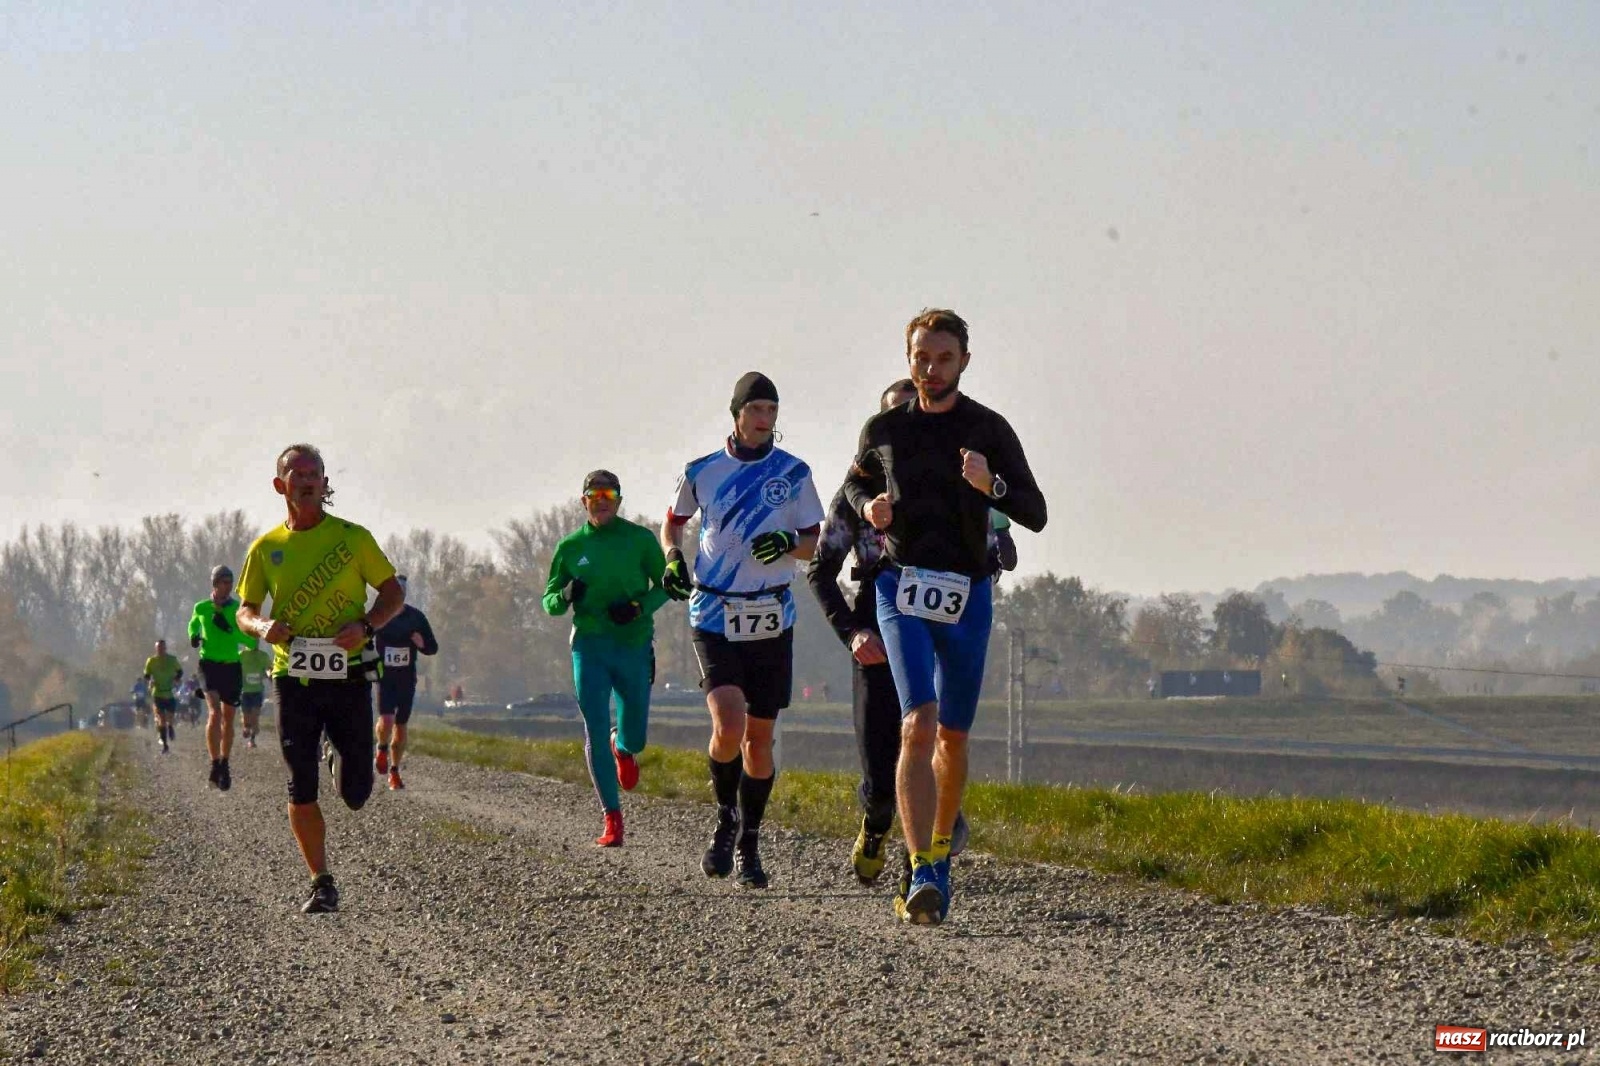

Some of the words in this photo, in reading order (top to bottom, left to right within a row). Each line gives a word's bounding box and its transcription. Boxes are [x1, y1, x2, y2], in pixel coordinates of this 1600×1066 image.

[903, 583, 963, 615] 103
[729, 613, 779, 634] 173
[291, 652, 344, 672] 206
[386, 653, 409, 663] 164
